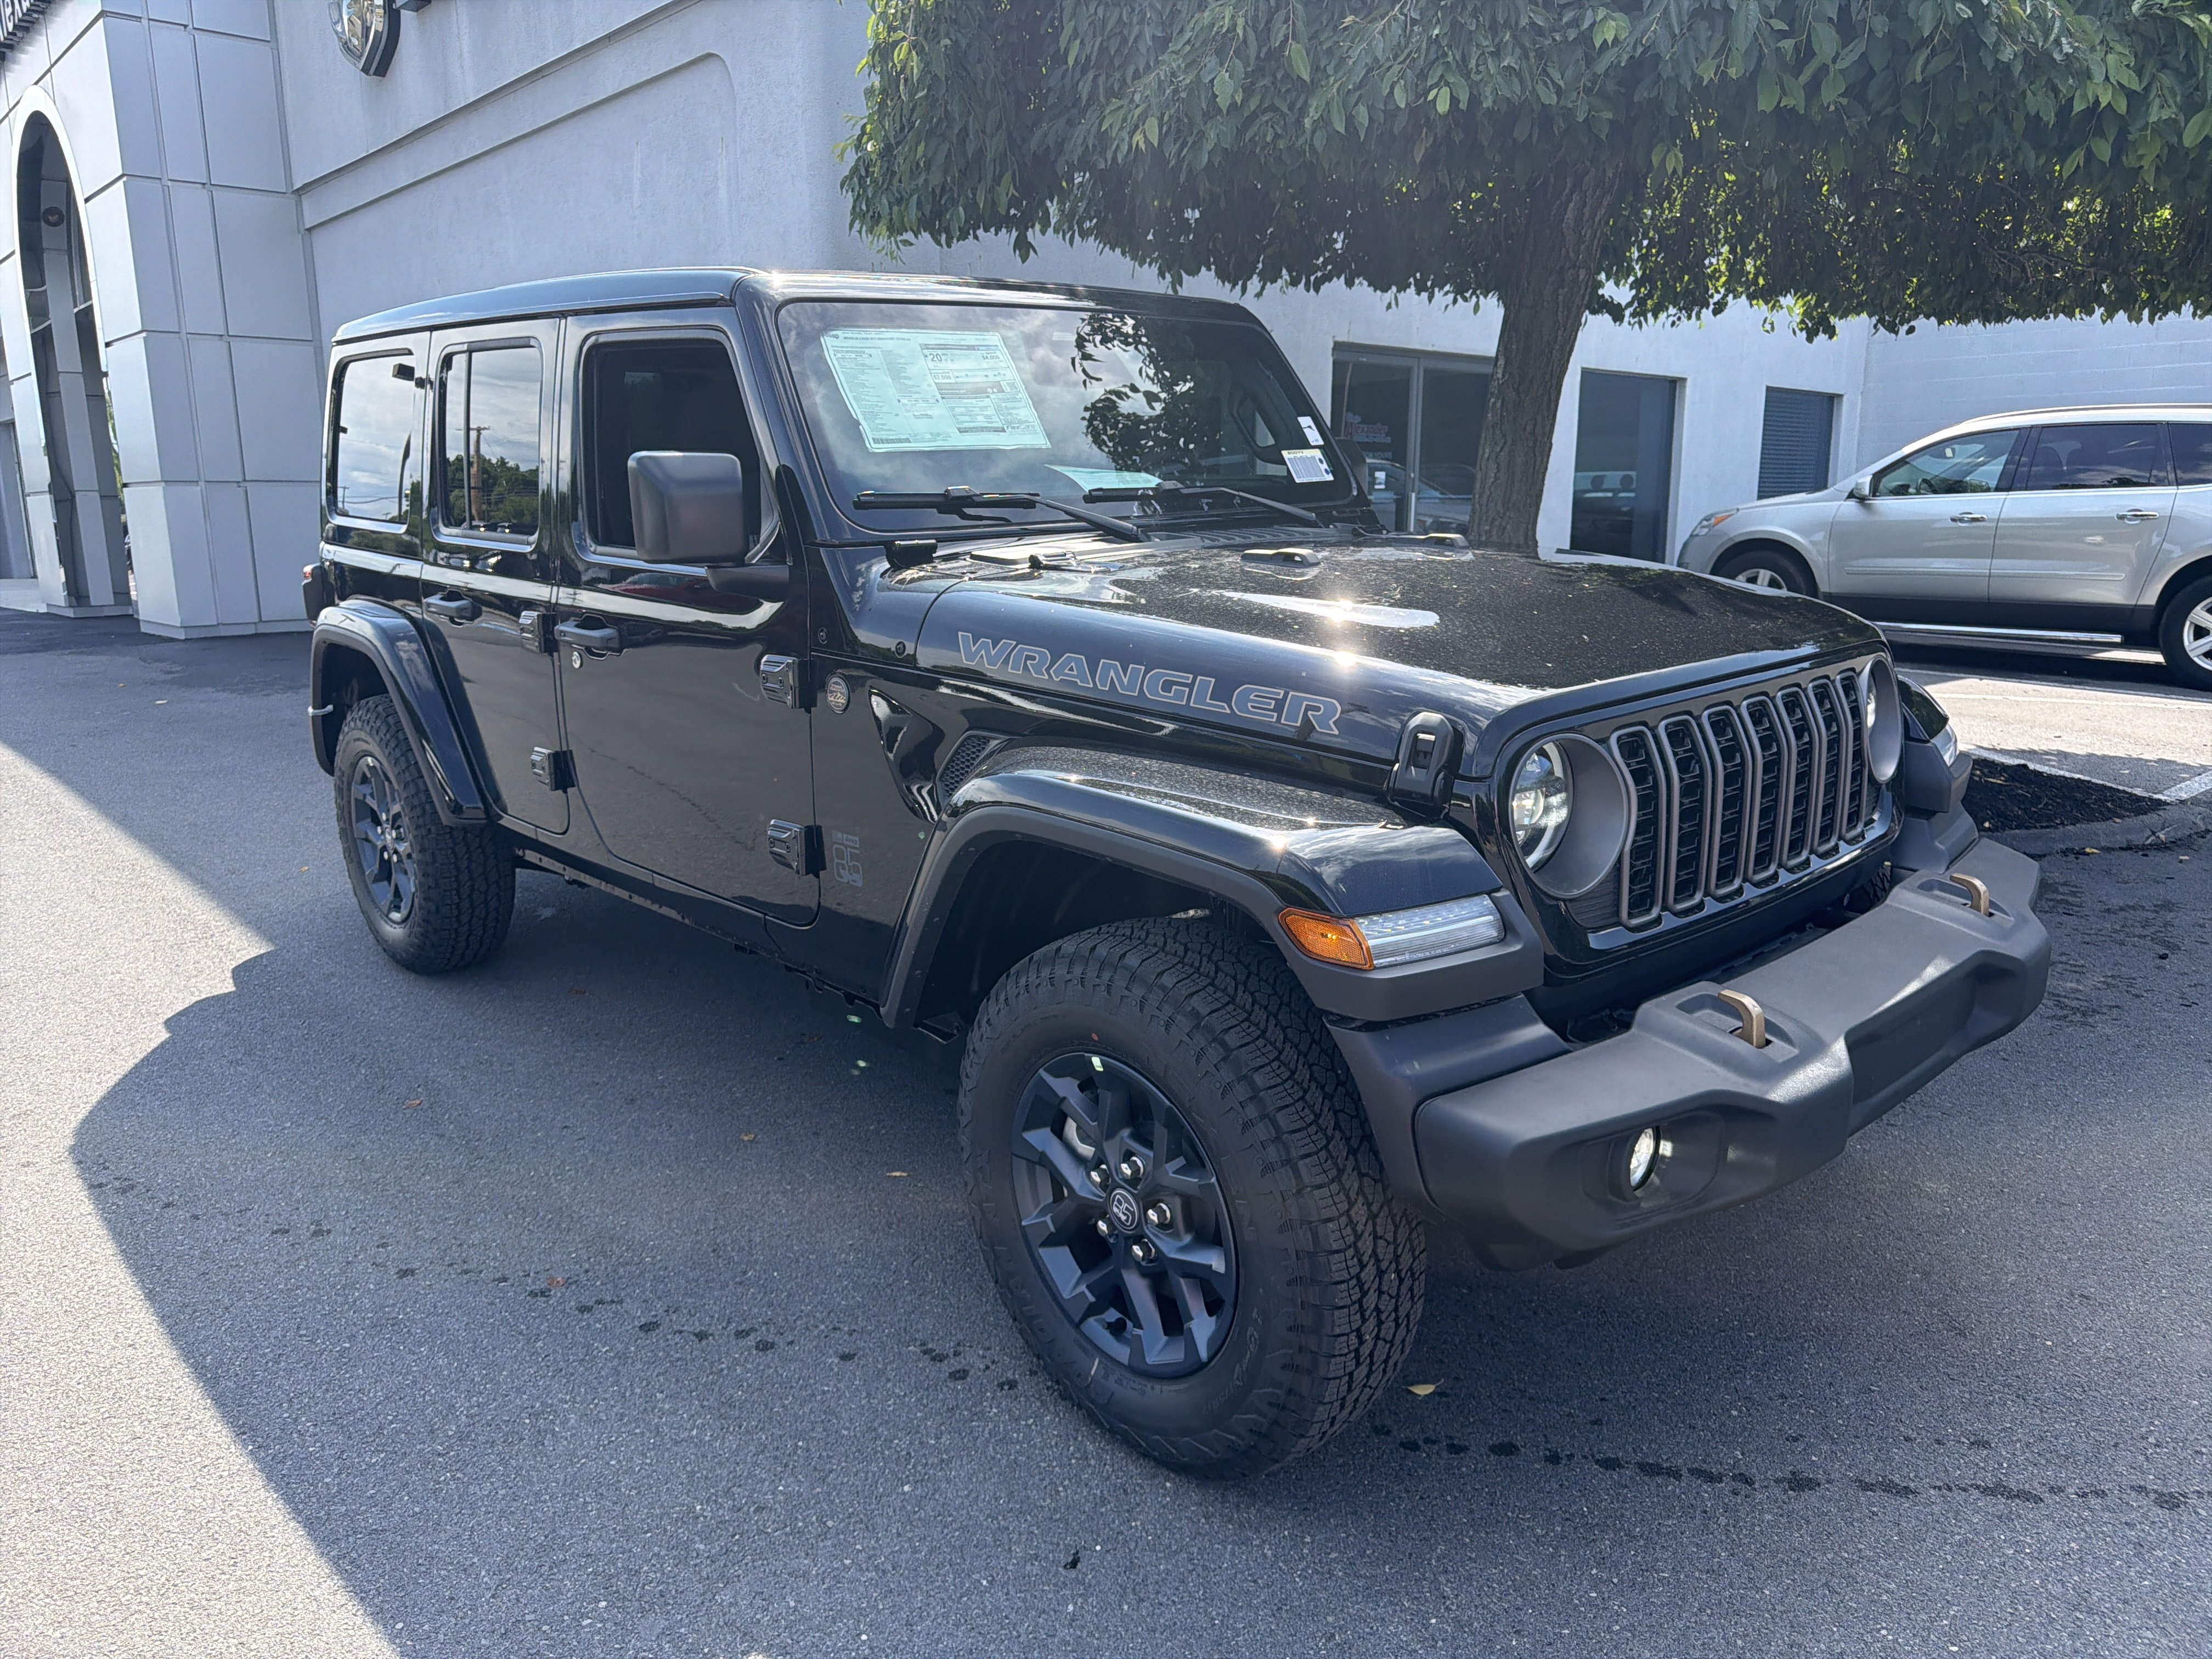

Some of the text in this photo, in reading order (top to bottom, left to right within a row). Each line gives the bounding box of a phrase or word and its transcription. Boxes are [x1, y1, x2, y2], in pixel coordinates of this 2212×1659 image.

[929, 353, 943, 362] 20
[957, 630, 1342, 735] WRANGLER
[833, 844, 863, 887] 85
[1112, 1194, 1134, 1226] 85
